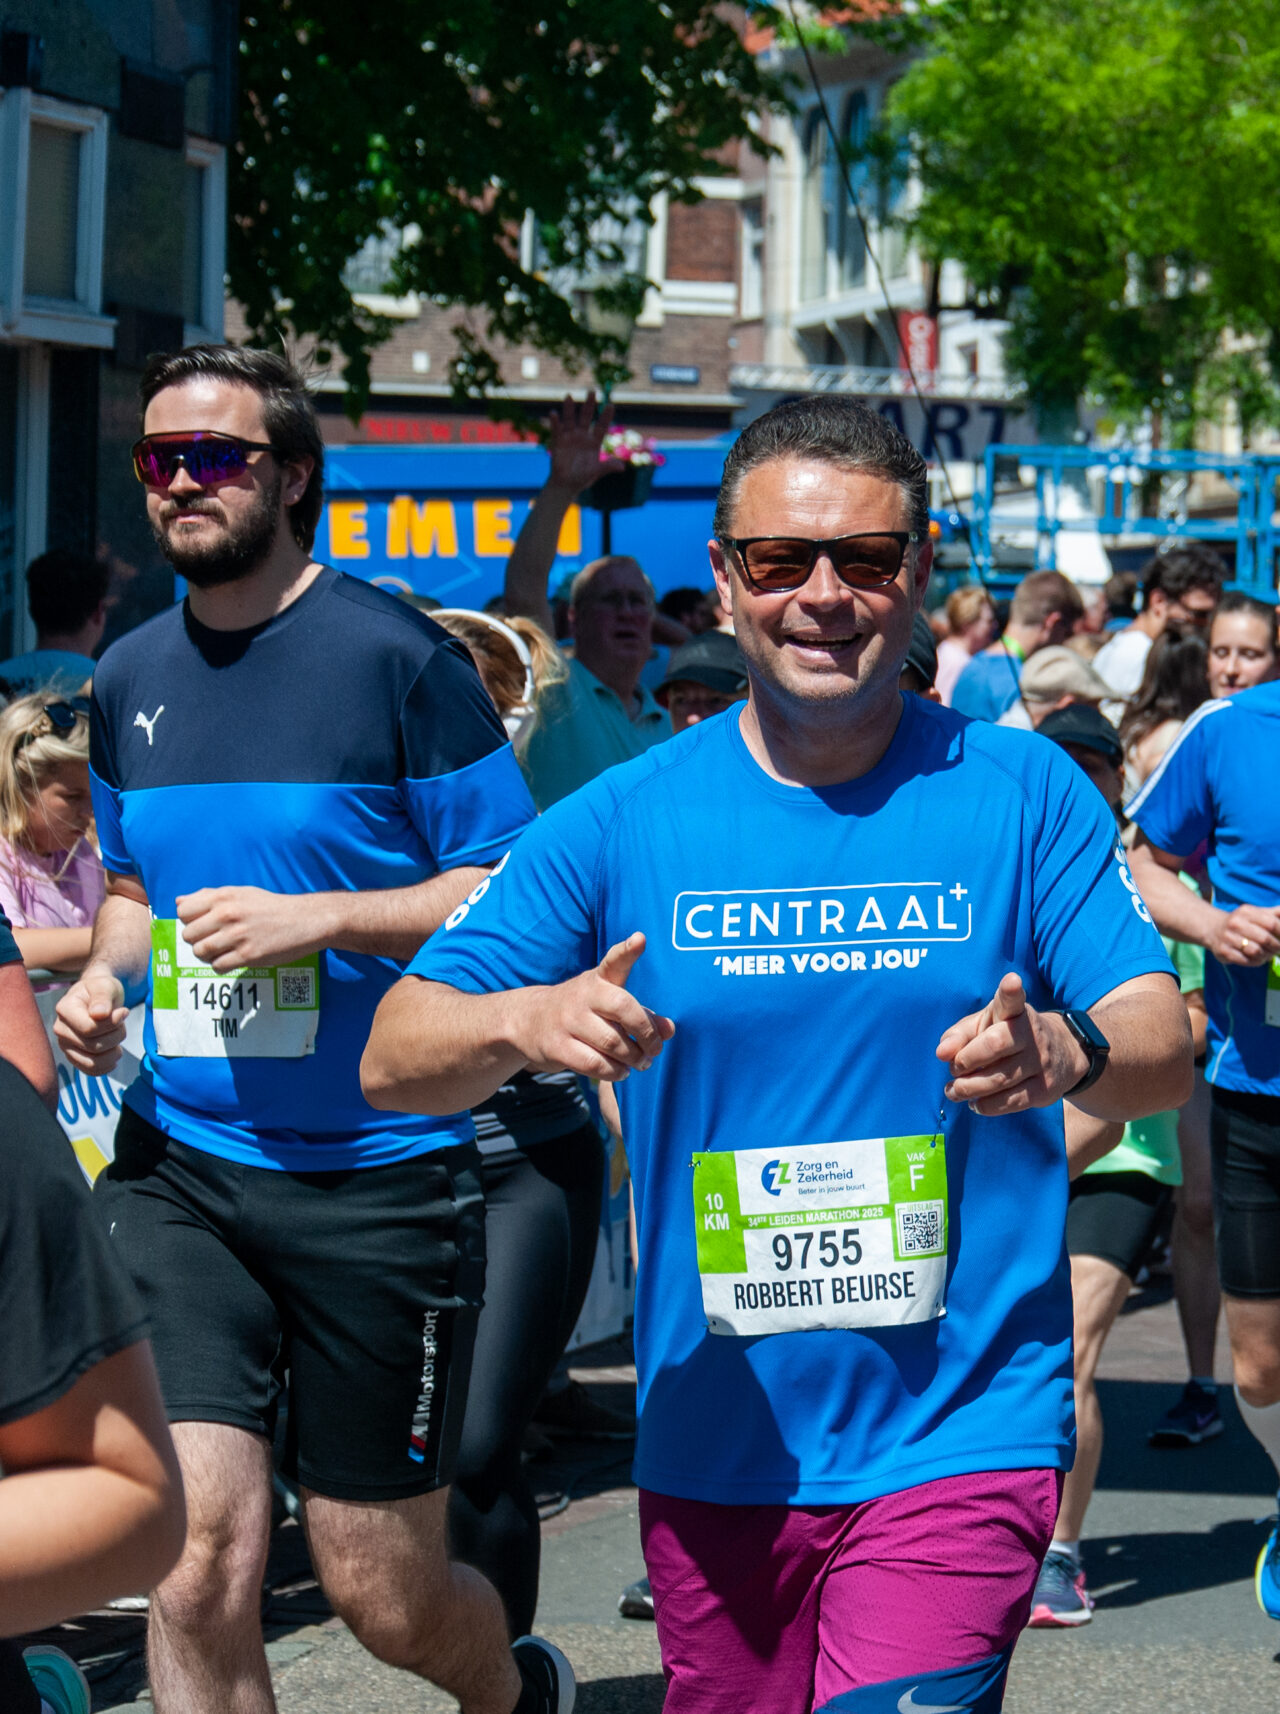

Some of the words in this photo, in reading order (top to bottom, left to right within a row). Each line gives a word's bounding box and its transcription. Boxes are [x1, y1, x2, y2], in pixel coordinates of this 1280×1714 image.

[158, 949, 169, 962] 10
[790, 951, 867, 973] VOOR
[156, 965, 172, 977] KM
[189, 982, 259, 1010] 14611
[212, 1018, 238, 1038] TIM
[906, 1151, 926, 1162] VAK
[796, 1161, 822, 1172] Zorg
[825, 1161, 839, 1169] en
[797, 1169, 853, 1183] Zekerheid
[909, 1164, 925, 1192] F
[705, 1193, 723, 1211] 10
[704, 1213, 730, 1231] KM
[769, 1214, 803, 1226] LEIDEN
[806, 1209, 860, 1222] MARATHON
[862, 1207, 884, 1218] 2025
[772, 1228, 863, 1271] 9755
[733, 1278, 825, 1310] ROBBERT
[831, 1271, 916, 1304] BEURSE
[416, 1310, 440, 1412] Motorsport
